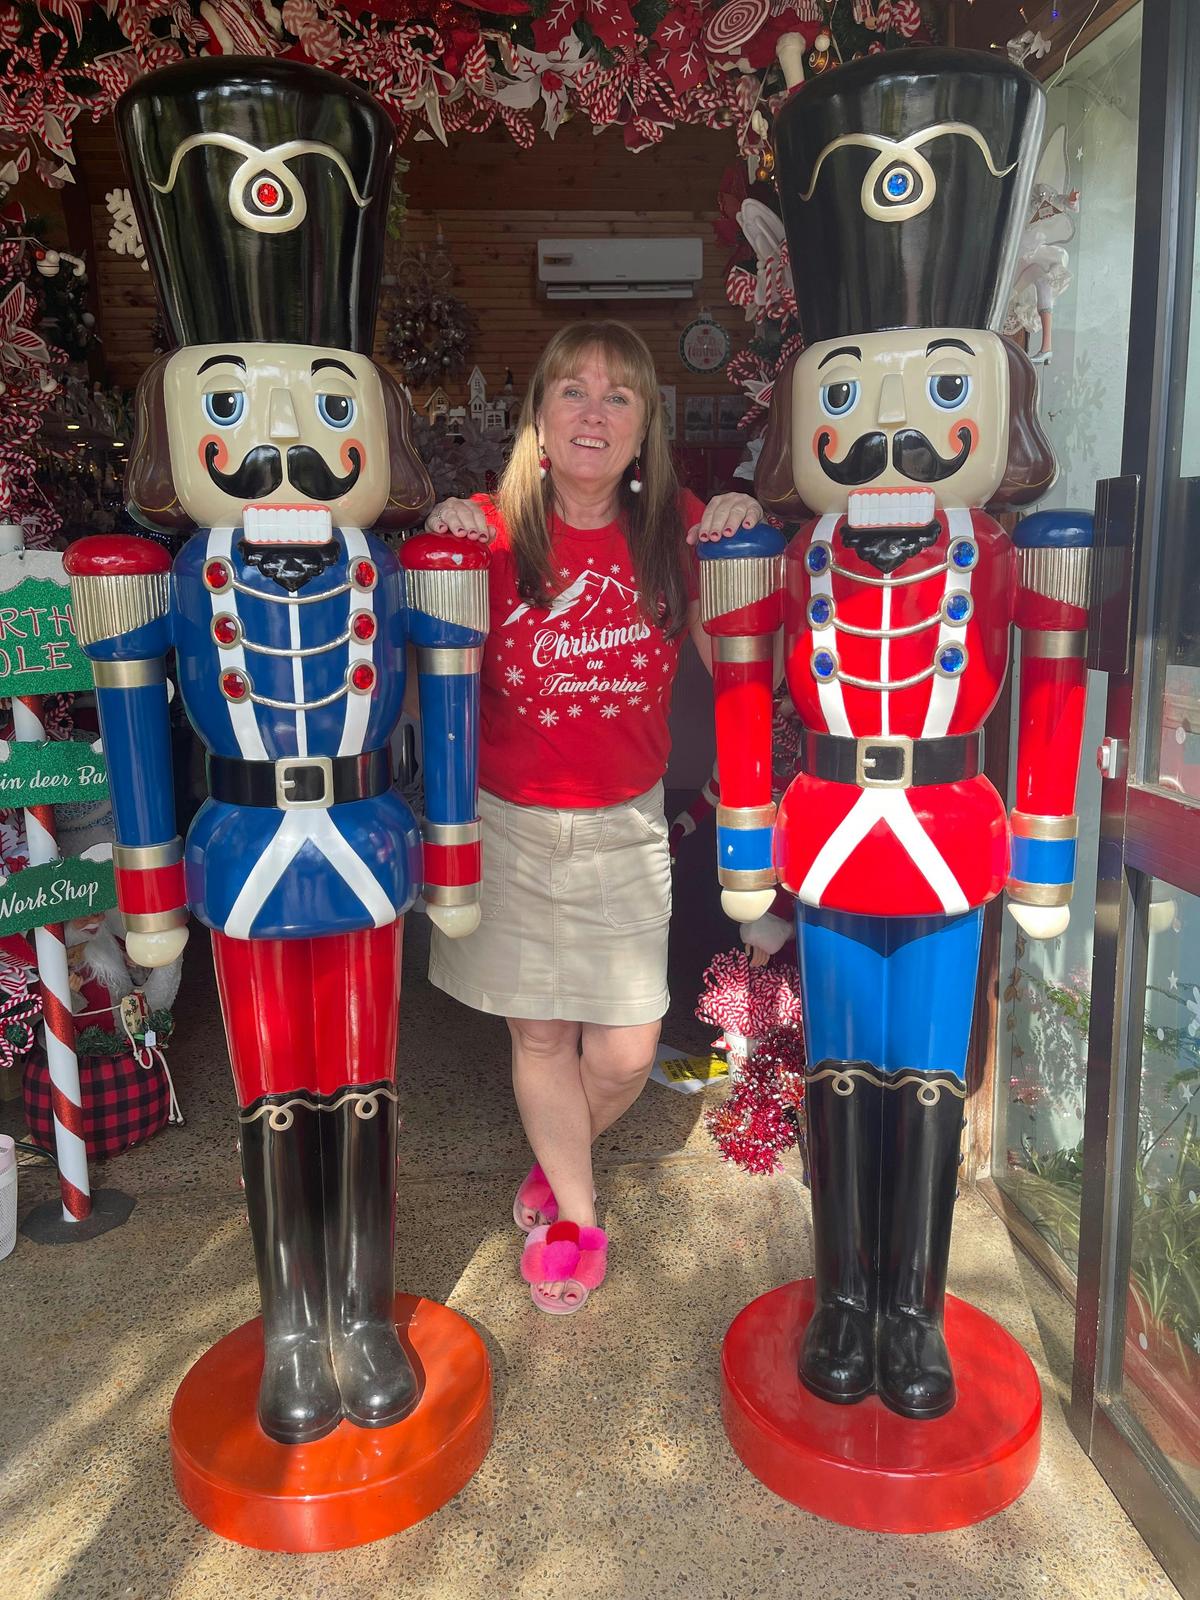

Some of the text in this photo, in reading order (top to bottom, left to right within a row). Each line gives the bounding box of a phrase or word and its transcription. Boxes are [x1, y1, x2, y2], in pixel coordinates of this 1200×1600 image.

[532, 619, 651, 668] Christmas
[586, 658, 604, 670] on
[540, 672, 647, 696] Tamborine
[30, 769, 72, 789] deer
[77, 765, 108, 786] Ba
